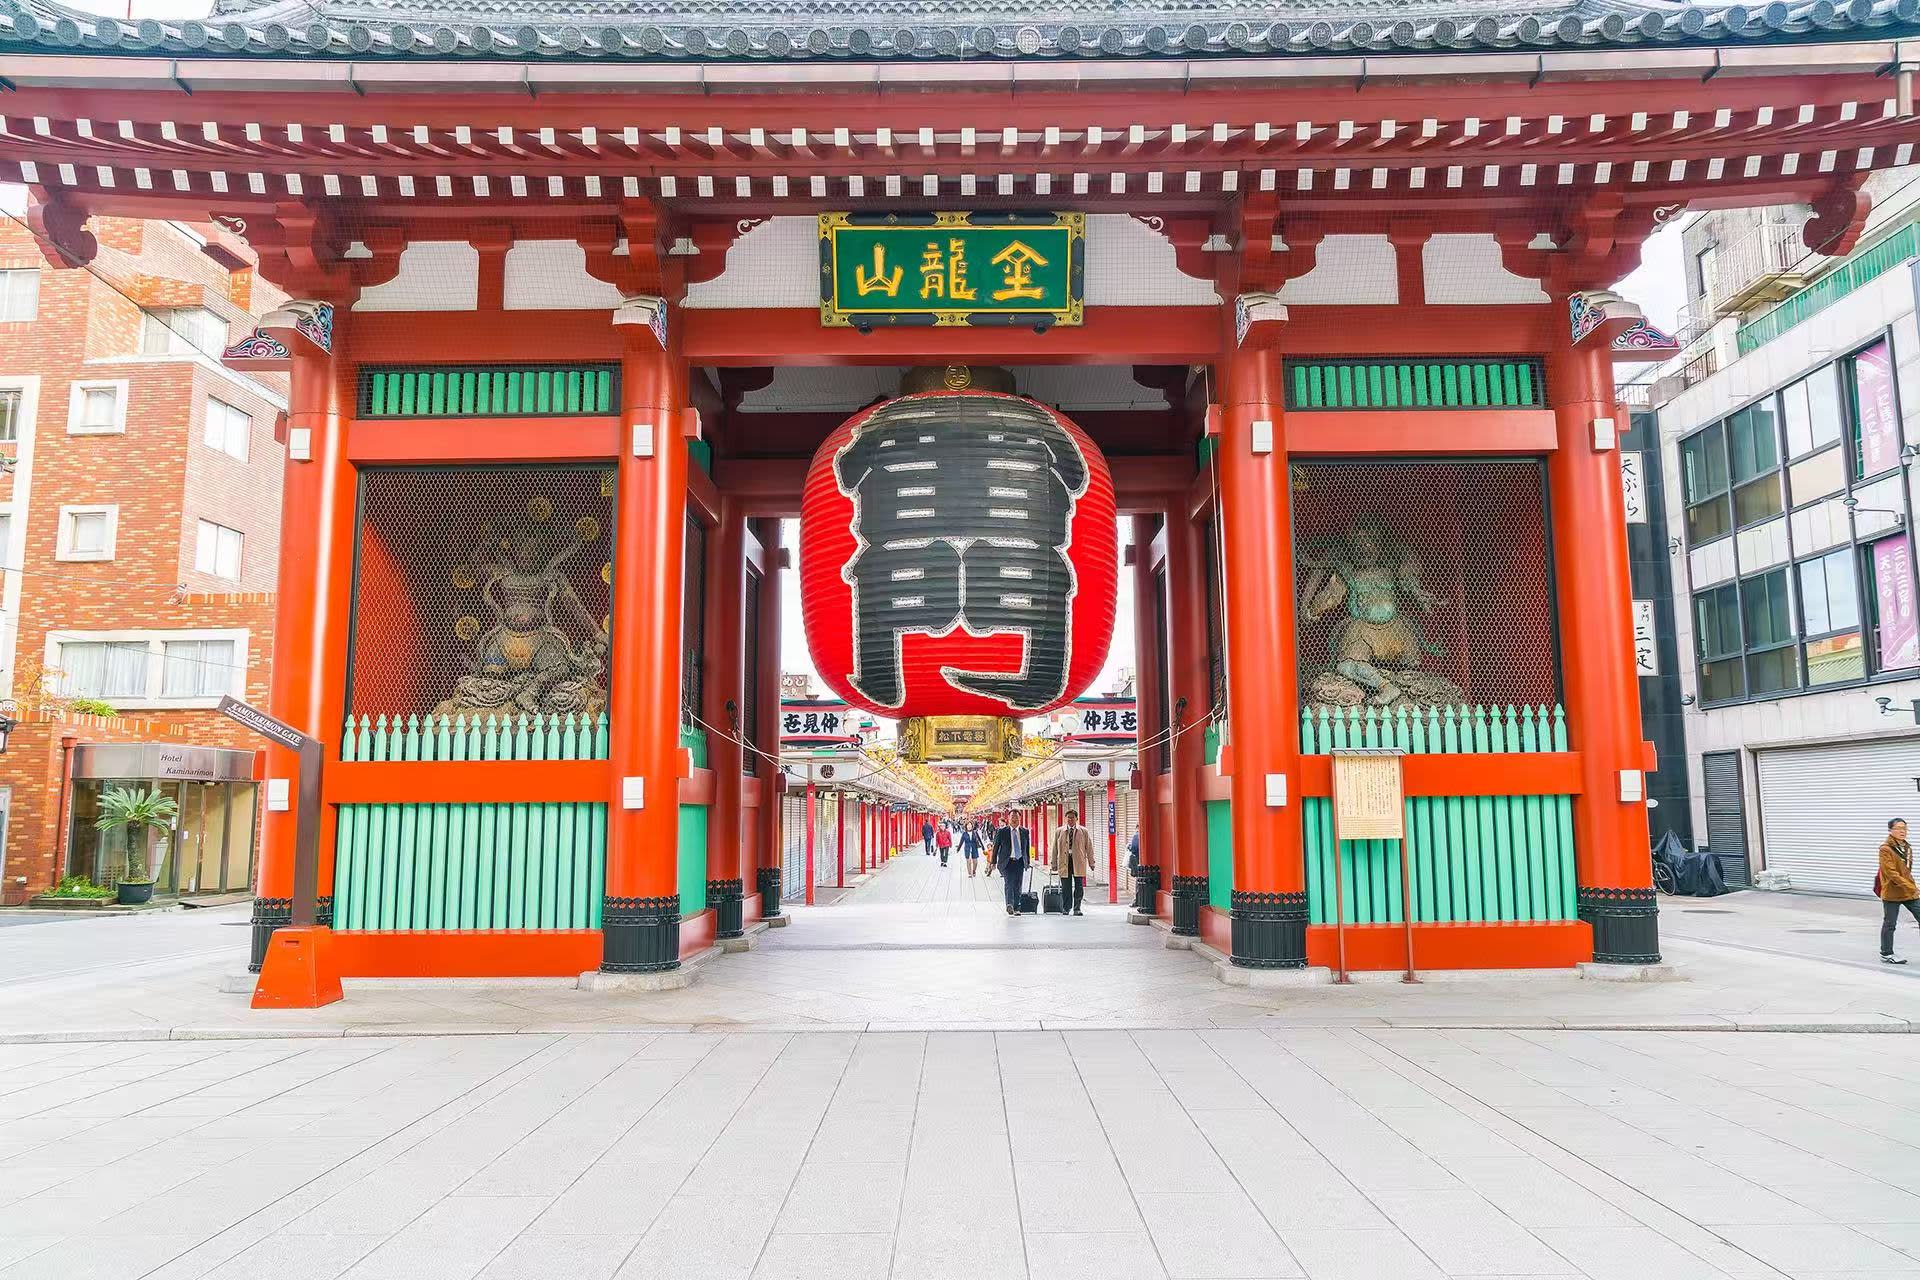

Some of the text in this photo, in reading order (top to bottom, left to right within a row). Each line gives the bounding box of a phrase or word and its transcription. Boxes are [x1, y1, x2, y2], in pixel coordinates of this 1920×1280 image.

[230, 703, 282, 734] KAMINARIMON
[281, 729, 303, 744] GATE
[160, 754, 183, 762] Hotel
[165, 767, 214, 777] Kaminarimon
